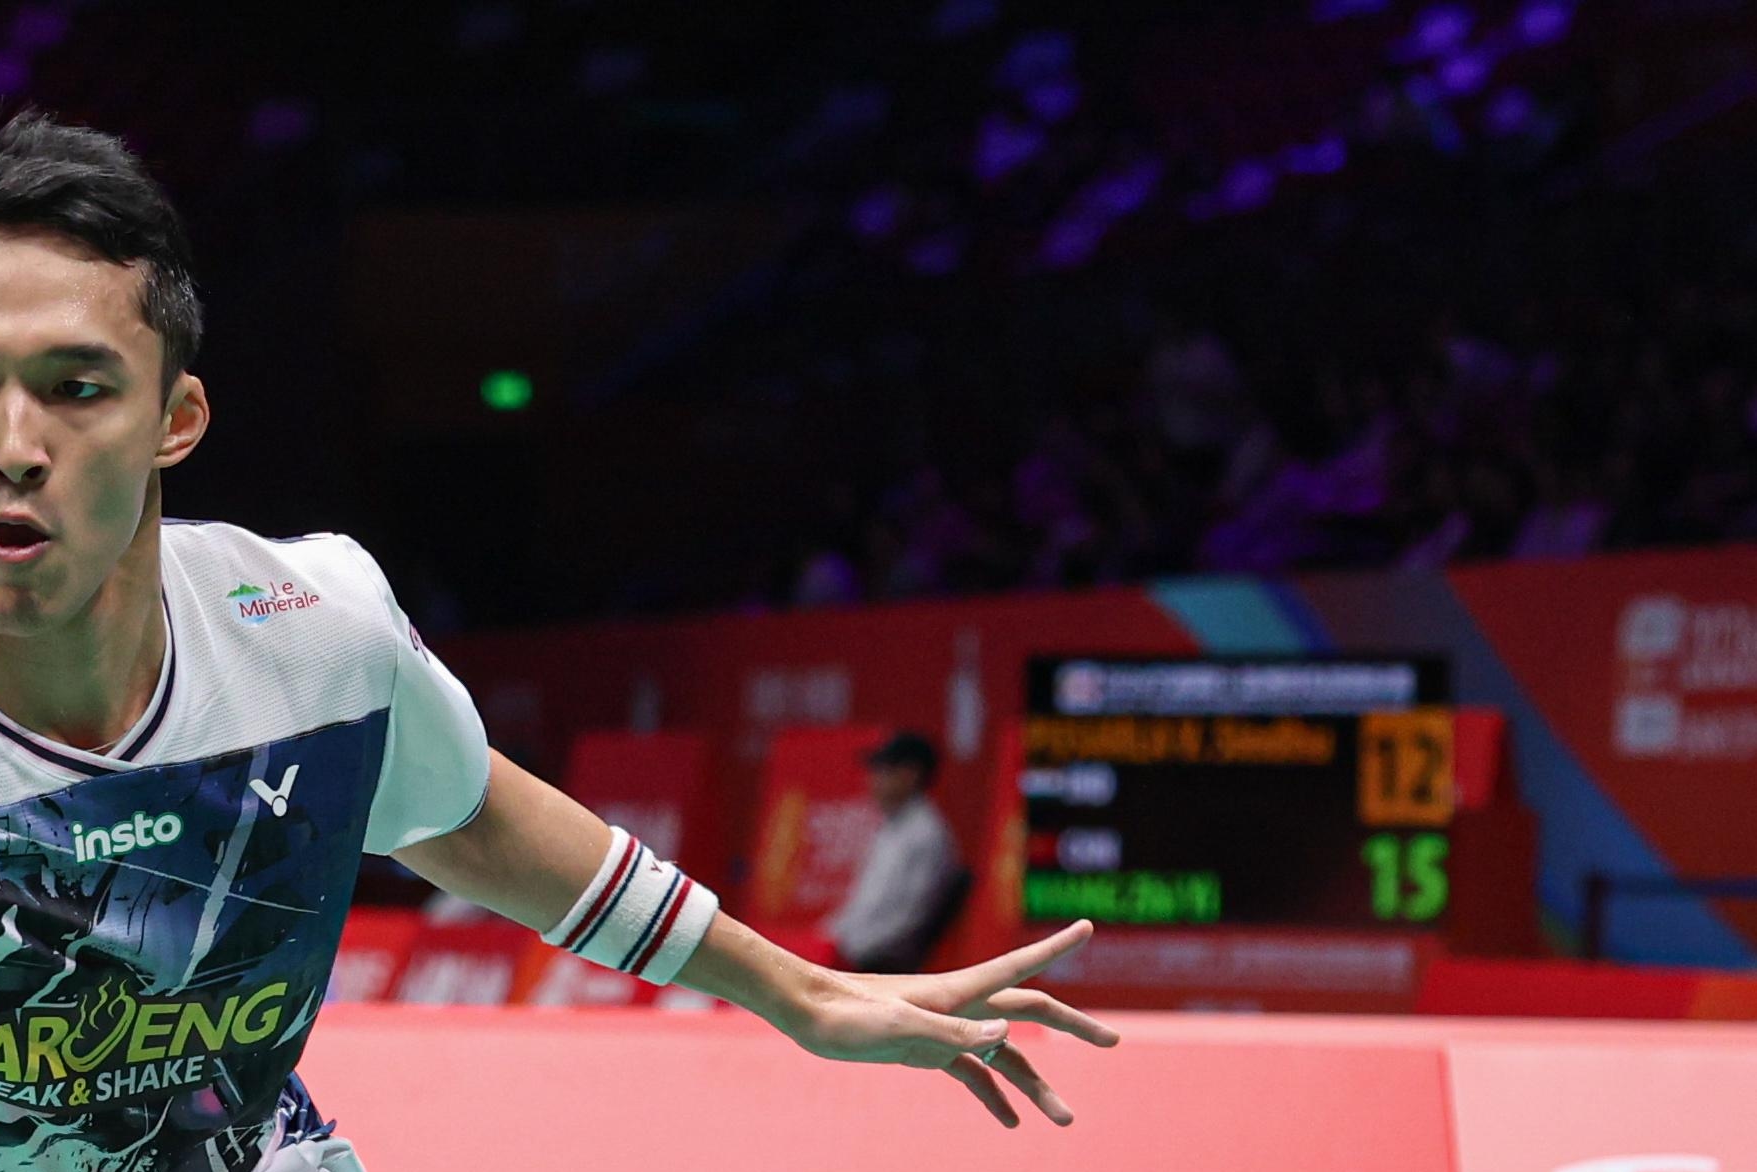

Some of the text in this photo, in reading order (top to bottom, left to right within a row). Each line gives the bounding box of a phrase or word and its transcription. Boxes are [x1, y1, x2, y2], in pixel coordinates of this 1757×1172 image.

[238, 592, 320, 618] Minerale
[270, 581, 294, 597] Le
[1377, 733, 1445, 805] 12
[72, 811, 184, 864] insto
[1360, 833, 1450, 921] 15
[68, 1076, 90, 1106] &
[95, 1054, 205, 1102] SHAKE
